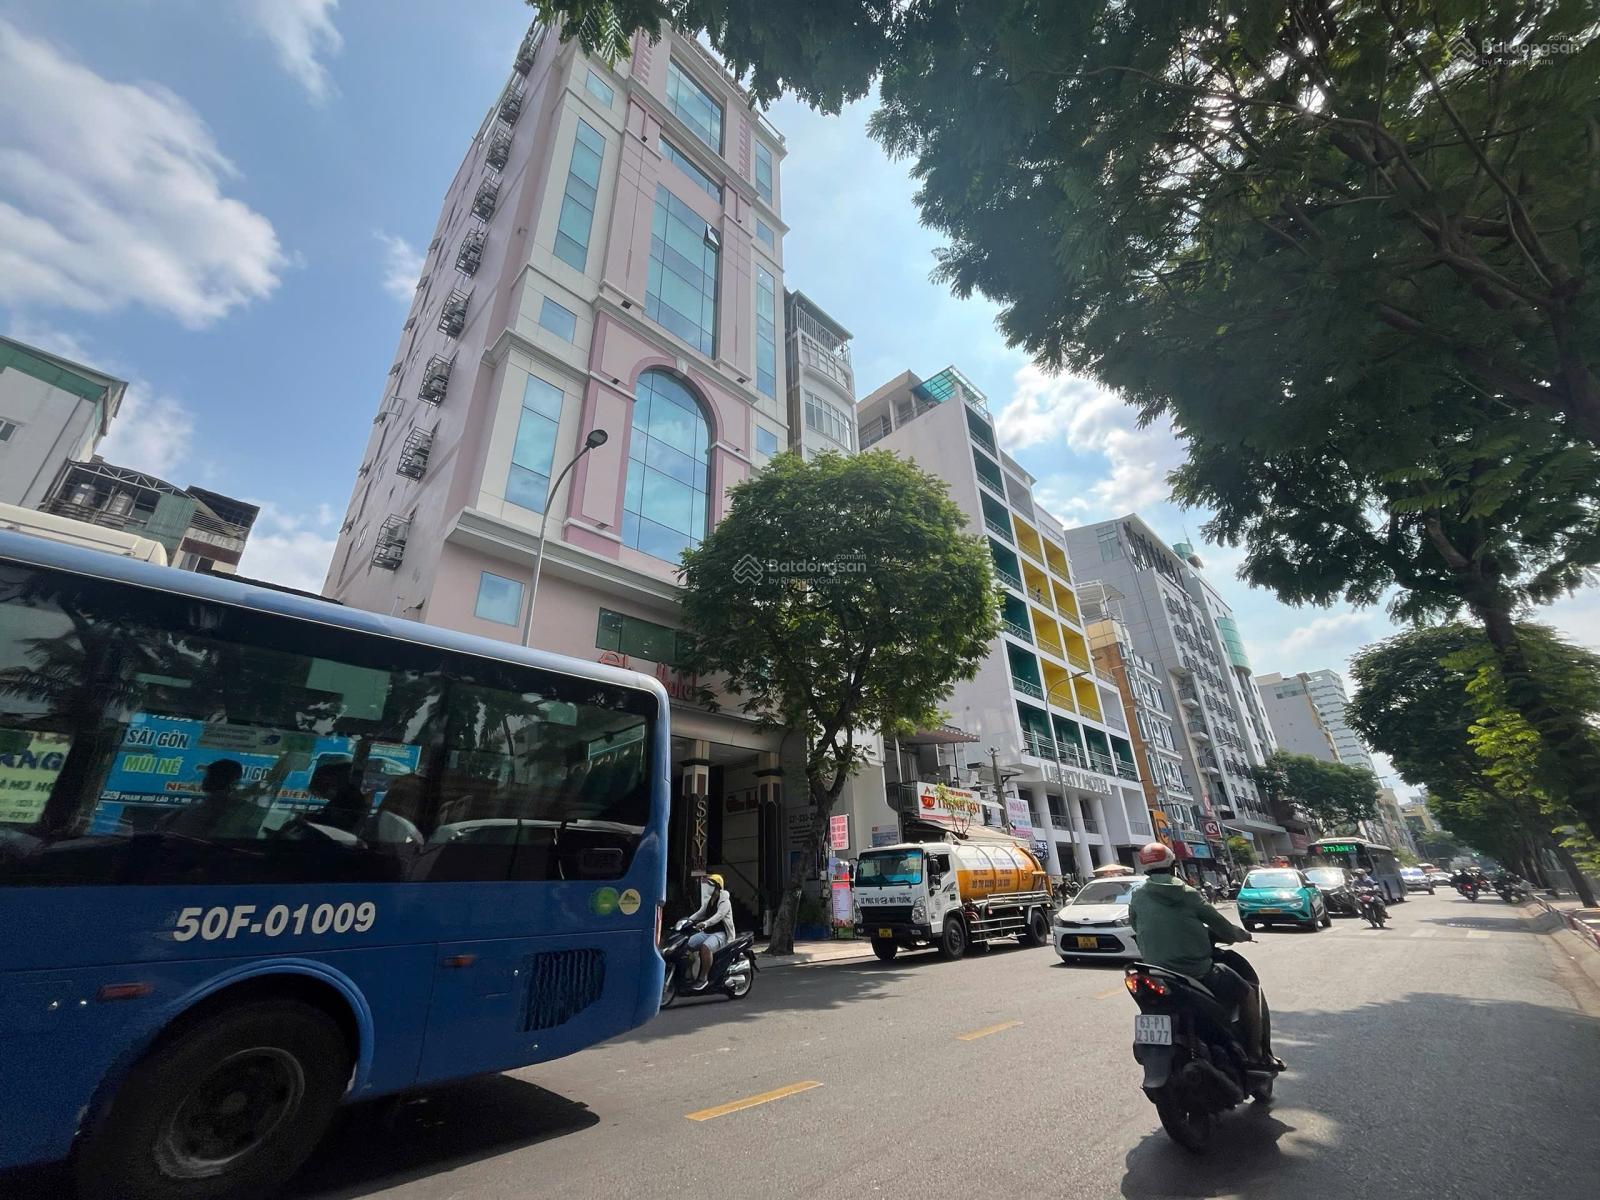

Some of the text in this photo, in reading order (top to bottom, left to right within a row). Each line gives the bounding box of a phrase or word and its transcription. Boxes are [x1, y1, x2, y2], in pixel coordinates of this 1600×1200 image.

[157, 730, 190, 749] GÒN
[696, 801, 707, 856] SKY
[173, 902, 376, 942] 50F-01009
